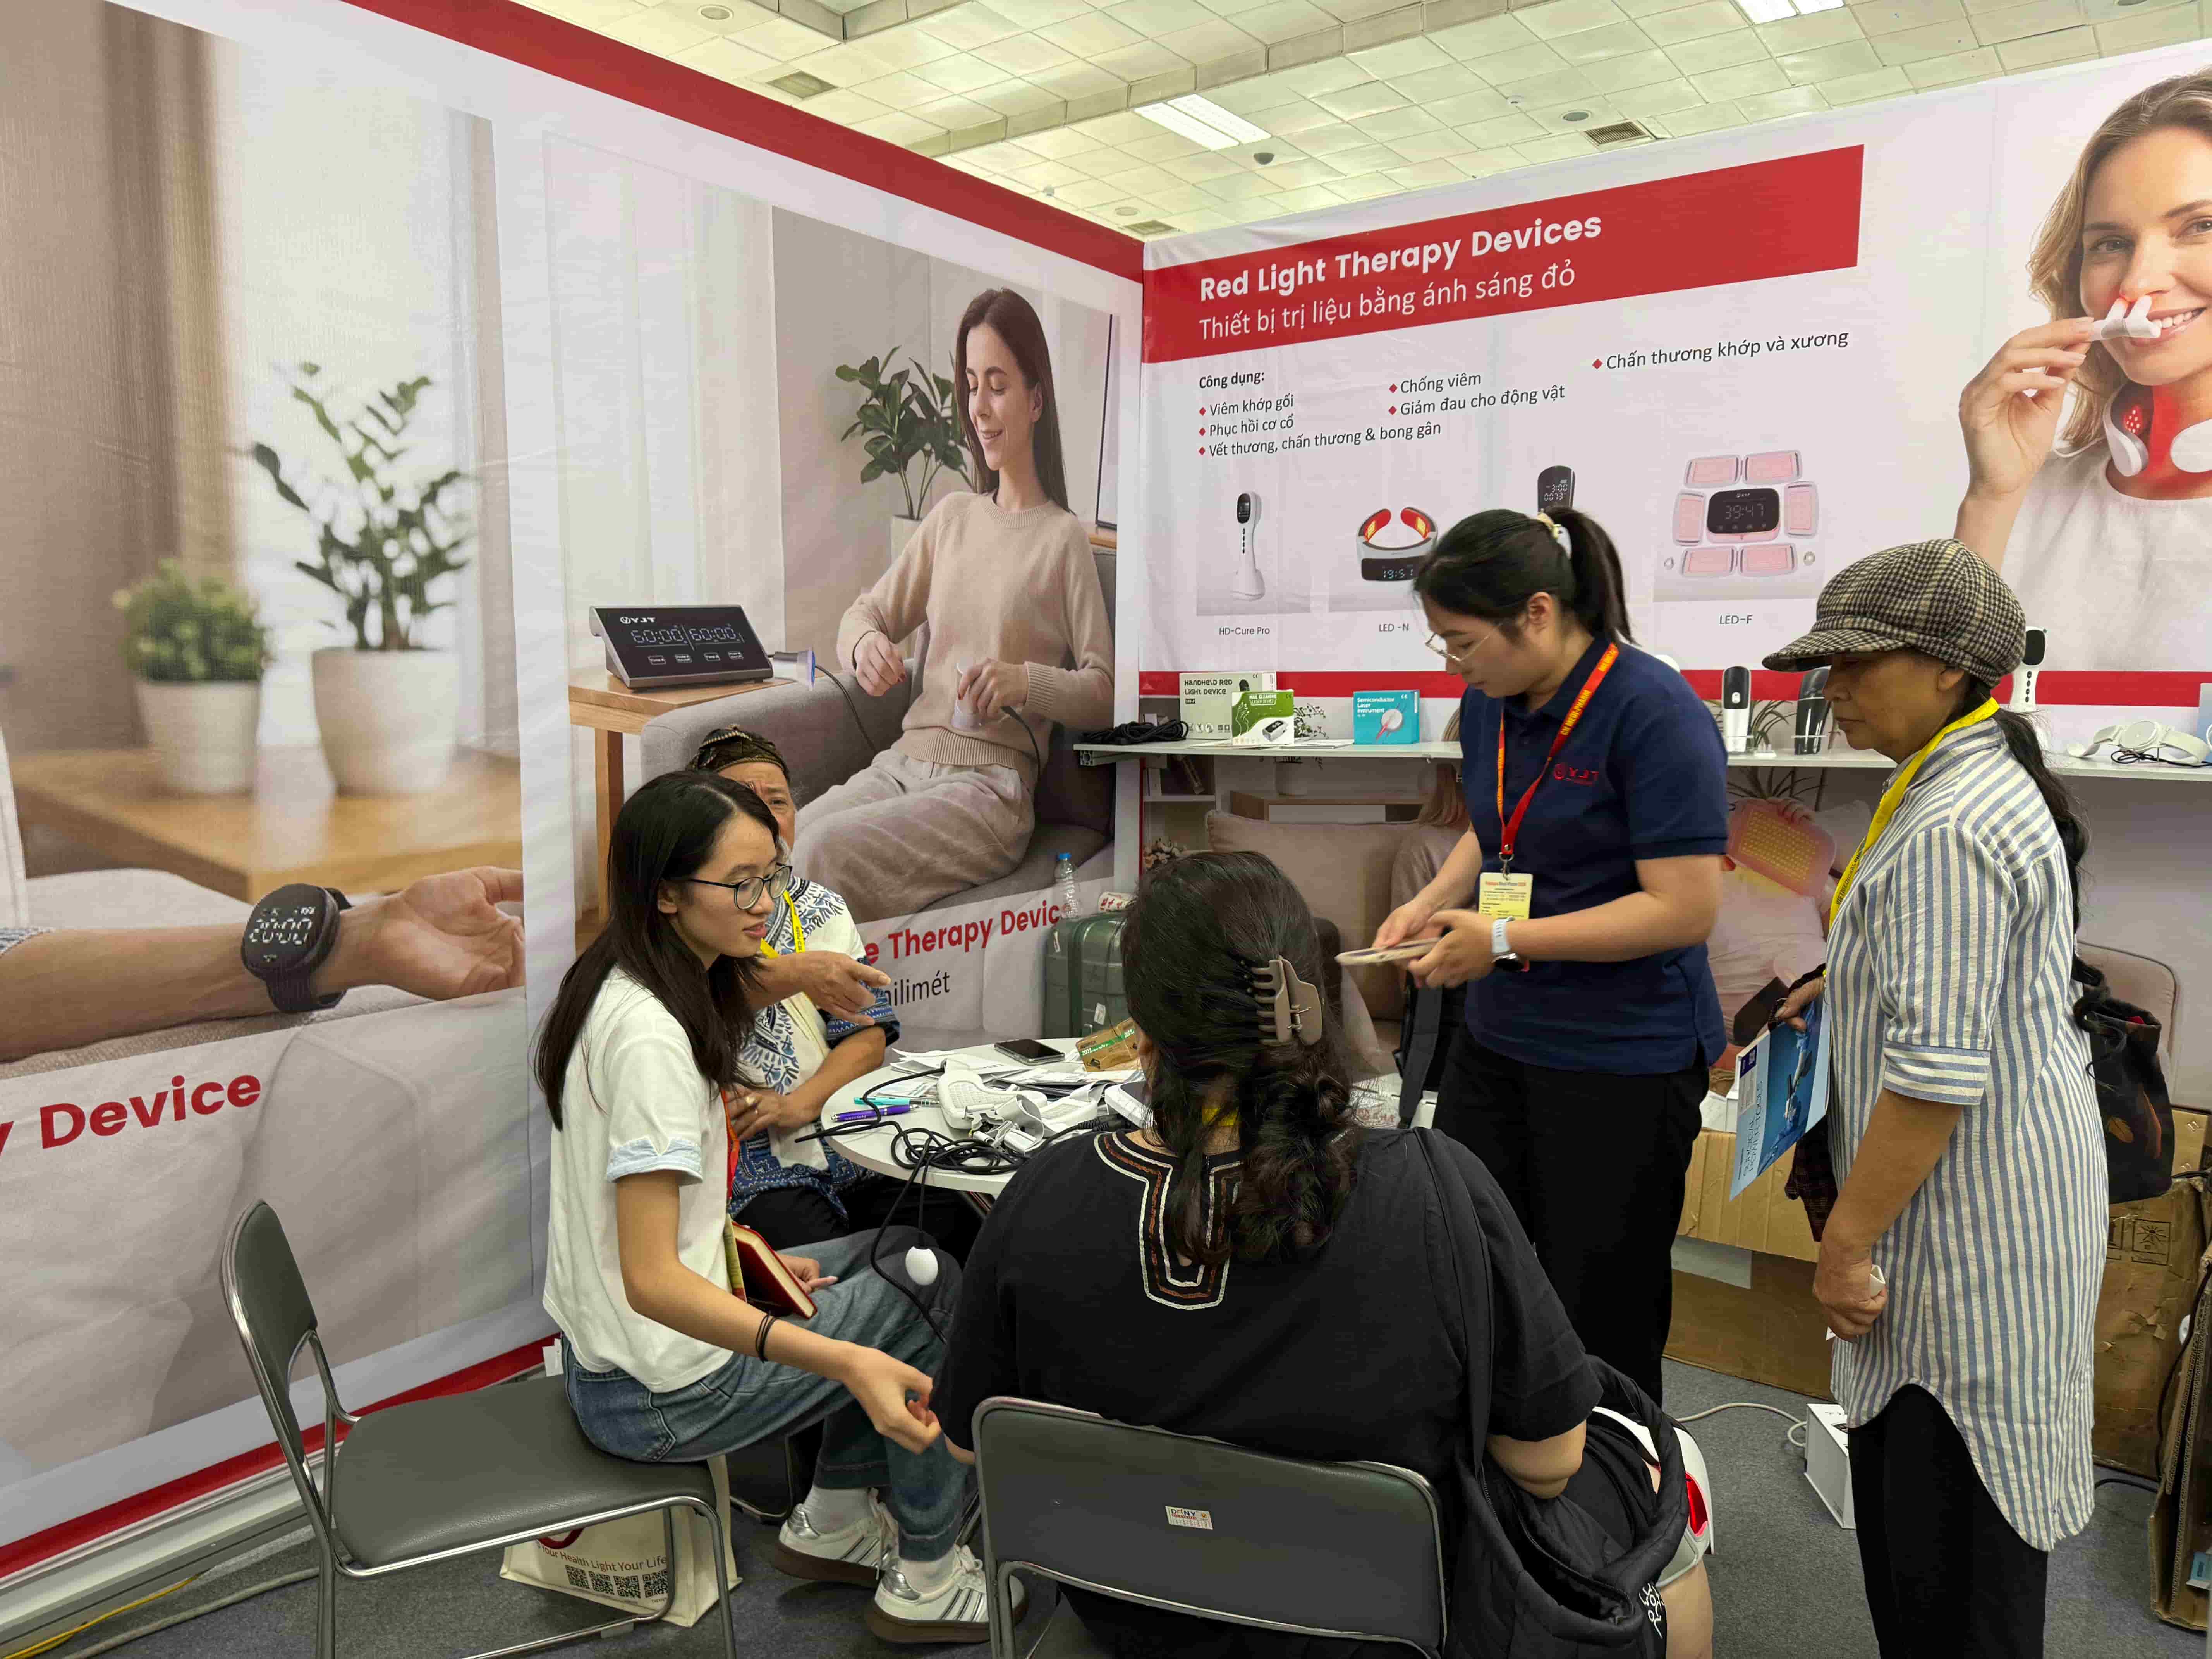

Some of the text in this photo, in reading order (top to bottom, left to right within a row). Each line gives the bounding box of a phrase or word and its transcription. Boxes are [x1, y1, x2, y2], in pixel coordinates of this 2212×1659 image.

[1200, 216, 1602, 301] Red Light Therapy Devices
[1199, 259, 1575, 340] Thiết bị trị liệu bằng ánh sáng đỏ
[1606, 331, 1849, 369] Chấn thương khớp và xương
[1199, 372, 1264, 388] Công dụng:
[1400, 373, 1481, 393] Chống viêm
[1210, 393, 1294, 416] Viêm khớp gối
[1400, 385, 1565, 416] Giảm đau cho động vật
[1209, 422, 1237, 437] Phục
[1240, 418, 1259, 433] hồi
[1262, 419, 1277, 431] cơ
[1209, 421, 1441, 457] Vết thương, chấn thương & bong gân
[1219, 626, 1270, 635] HD-Cure Pro
[1379, 623, 1395, 632] LED
[1719, 615, 1753, 624] LED-F
[888, 917, 993, 960] Therapy
[40, 1074, 261, 1149] Device
[561, 1552, 589, 1567] Health
[590, 1559, 617, 1572] Light
[618, 1561, 644, 1571] Your
[646, 1556, 667, 1568] Life
